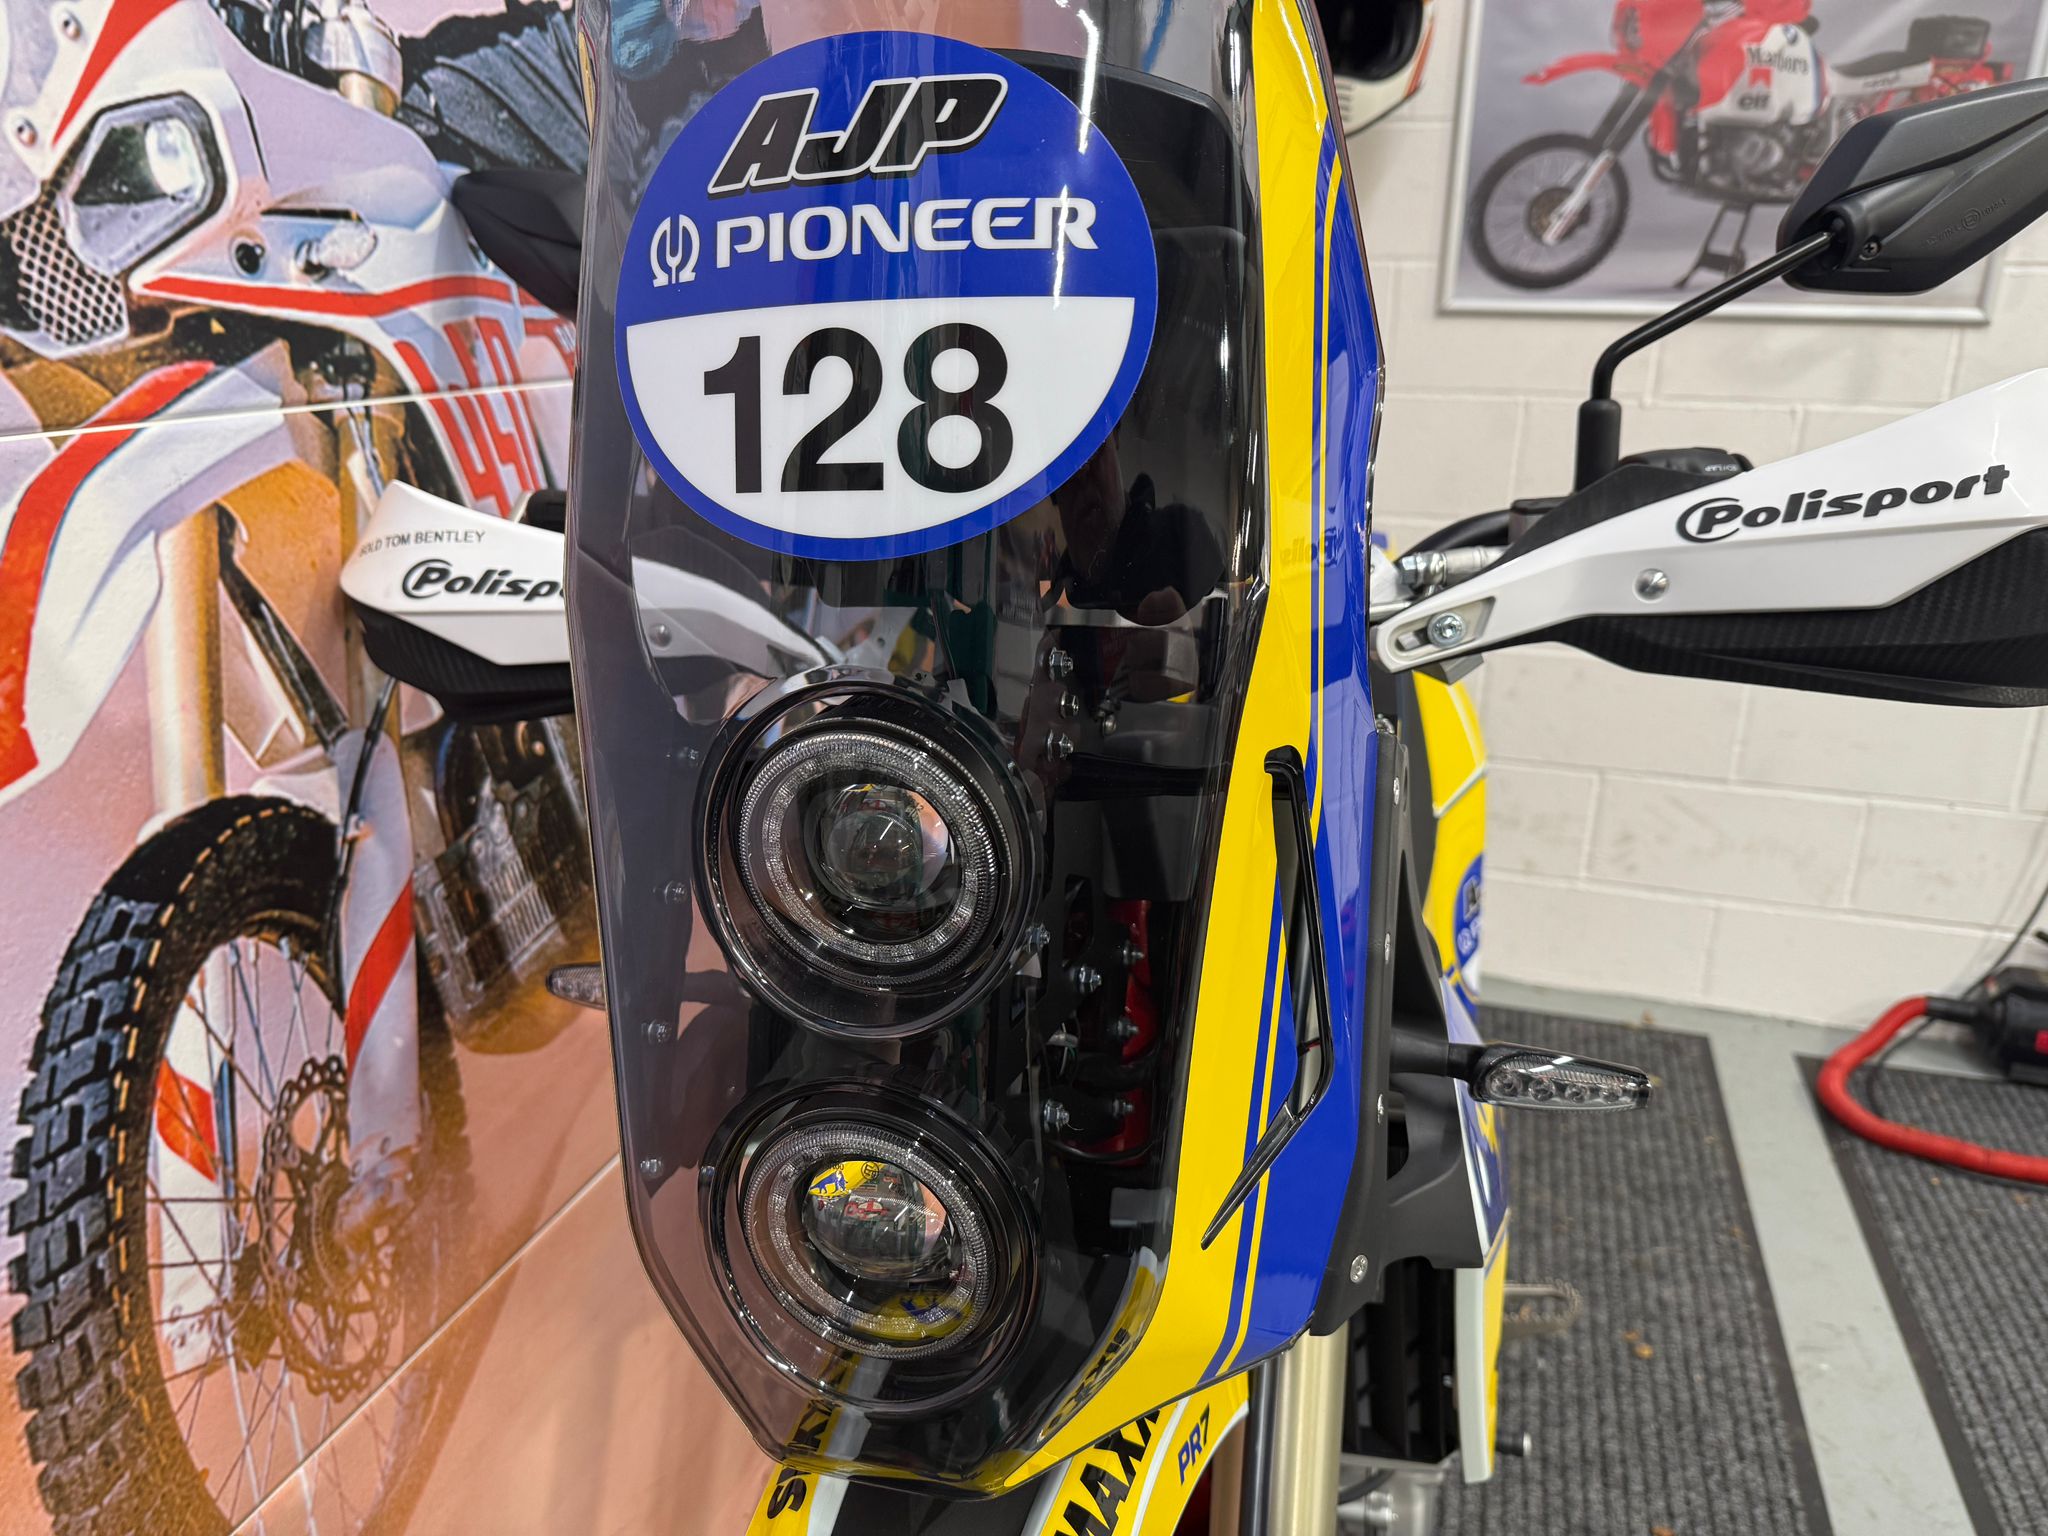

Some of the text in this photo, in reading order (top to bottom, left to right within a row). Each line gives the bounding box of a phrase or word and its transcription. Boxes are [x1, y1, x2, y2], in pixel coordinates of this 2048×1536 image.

[707, 72, 1008, 198] AJP
[715, 196, 1098, 268] PIONEER
[703, 322, 1014, 494] 128
[386, 533, 411, 548] TOM
[415, 530, 486, 544] BENTLEY
[1676, 464, 2010, 543] Polisport
[402, 559, 565, 602] Polisp
[1178, 1402, 1210, 1485] PR7
